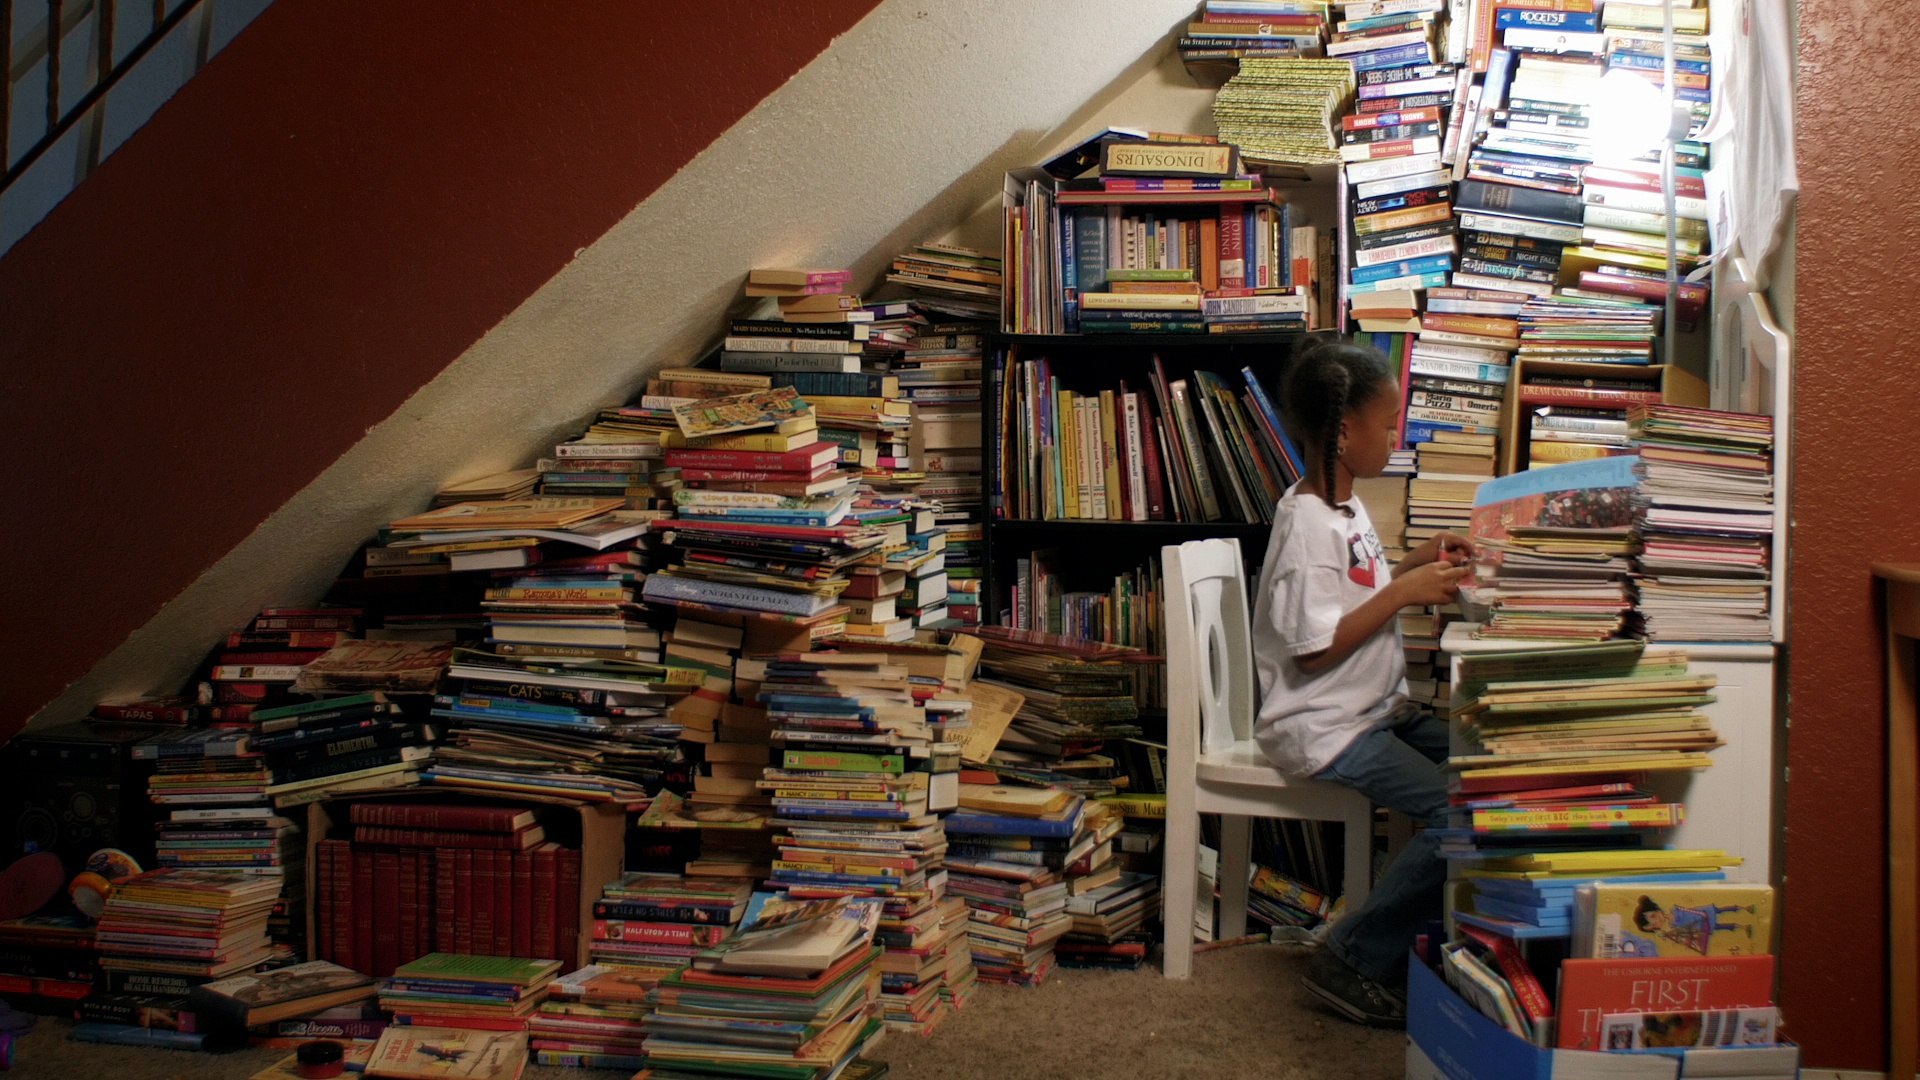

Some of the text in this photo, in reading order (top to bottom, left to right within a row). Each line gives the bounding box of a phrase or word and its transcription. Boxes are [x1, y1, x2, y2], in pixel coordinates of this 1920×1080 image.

[1520, 12, 1558, 22] ROGET'S
[1180, 38, 1232, 47] THE STREET LAWYER
[1366, 70, 1403, 85] HIDE SEEK
[1354, 112, 1424, 127] SANDRA BROWN
[1116, 154, 1204, 168] DINOSAURS
[1222, 215, 1230, 256] IRVING
[1406, 228, 1439, 238] PHANTOMS
[1477, 233, 1489, 244] ED
[1232, 218, 1240, 260] JOHN
[1516, 252, 1557, 265] NIGHT FALL
[1204, 299, 1256, 315] JOHN SANDFORD
[729, 338, 783, 350] JAMES PATTERSON
[796, 341, 817, 351] CRADLE
[740, 358, 773, 366] GRAFTON
[774, 356, 783, 368] P
[1419, 360, 1476, 374] SANDRA BROWN
[1524, 386, 1550, 395] DREAM
[1552, 388, 1585, 397] COUNTRY
[1426, 394, 1452, 403] Mario
[1425, 400, 1451, 409] Puzo
[1468, 401, 1498, 411] Omerta
[1128, 414, 1136, 429] Take
[1535, 418, 1566, 429] SANDRA
[1129, 430, 1137, 444] Care
[1546, 447, 1564, 456] NORA
[1131, 454, 1139, 477] Yourself
[523, 588, 588, 599] Ramona's World
[672, 583, 698, 594] Disney
[1018, 577, 1026, 602] World
[702, 588, 790, 606] ENCHANTED TALES
[508, 684, 543, 699] CATS
[120, 710, 154, 720] TAPAS
[1119, 804, 1137, 814] STEEL
[1144, 802, 1166, 816] MALICE
[1553, 812, 1569, 821] BIG
[612, 906, 633, 916] FILM
[634, 908, 647, 917] ON
[625, 927, 643, 935] HALF
[644, 928, 663, 936] UPON
[672, 930, 690, 938] TIME
[1603, 965, 1737, 977] THE USBORNE INTERNET-LINKED
[128, 976, 187, 987] HOME REMEDIES
[123, 983, 191, 995] HEALTH HANDBOOK
[1631, 979, 1710, 1005] FIRST
[113, 1005, 132, 1014] BODY
